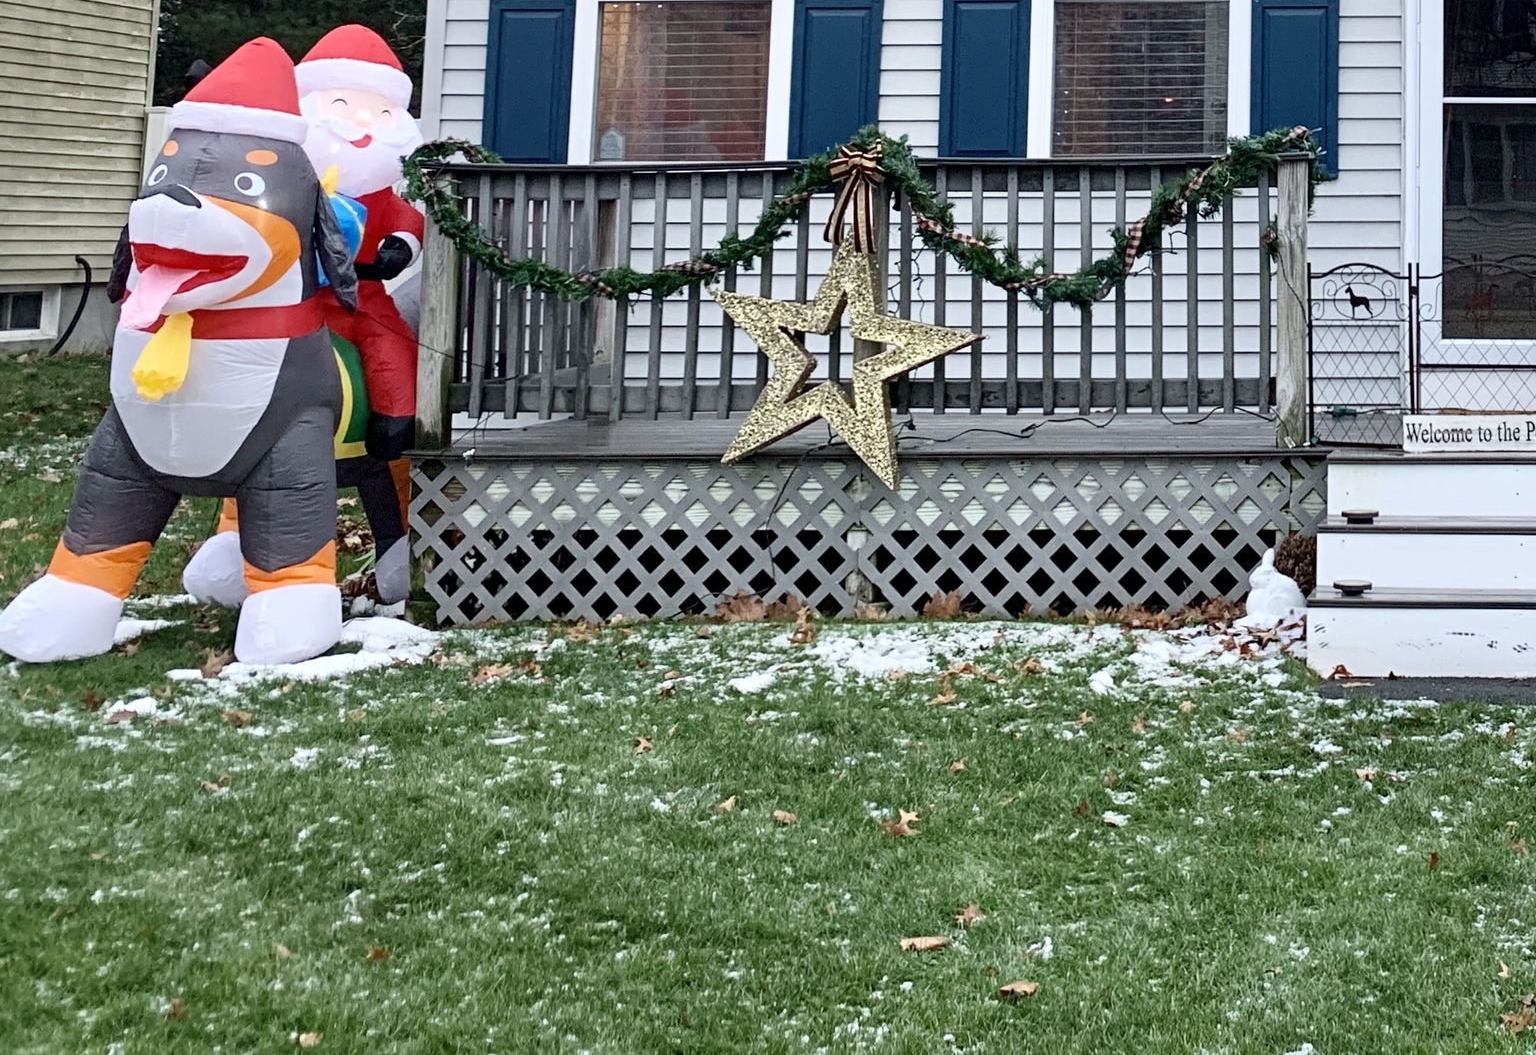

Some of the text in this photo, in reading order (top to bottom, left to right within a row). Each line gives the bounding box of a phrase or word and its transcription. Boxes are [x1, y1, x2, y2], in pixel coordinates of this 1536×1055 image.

[1405, 423, 1473, 444] Welcome
[1478, 425, 1492, 443] to
[1497, 421, 1521, 442] the
